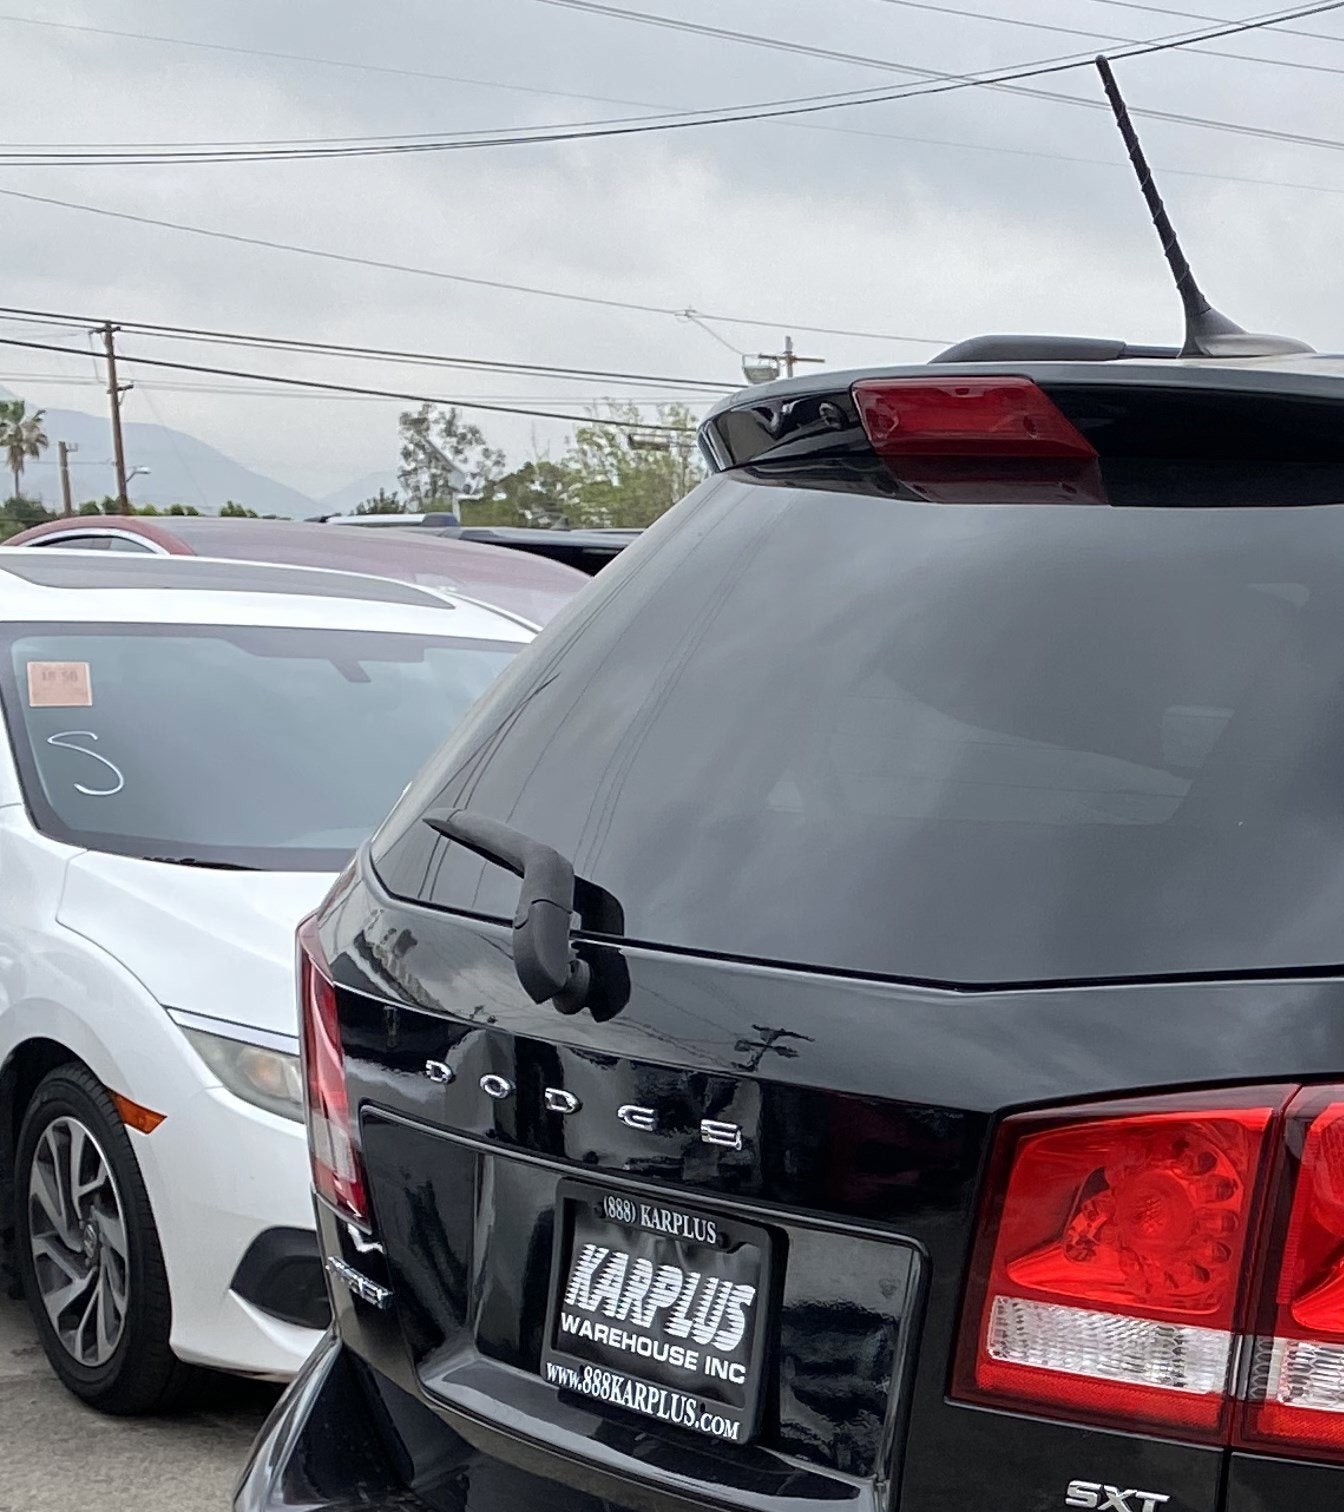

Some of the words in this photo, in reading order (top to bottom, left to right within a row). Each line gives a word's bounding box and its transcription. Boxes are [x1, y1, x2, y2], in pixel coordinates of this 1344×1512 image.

[425, 1058, 742, 1151] DODGE
[603, 1195, 637, 1225] (888)
[640, 1204, 718, 1245] KARPLUS
[564, 1242, 757, 1353] KARPLUS
[560, 1311, 700, 1372] WAREHOUSE
[704, 1354, 747, 1385] INC
